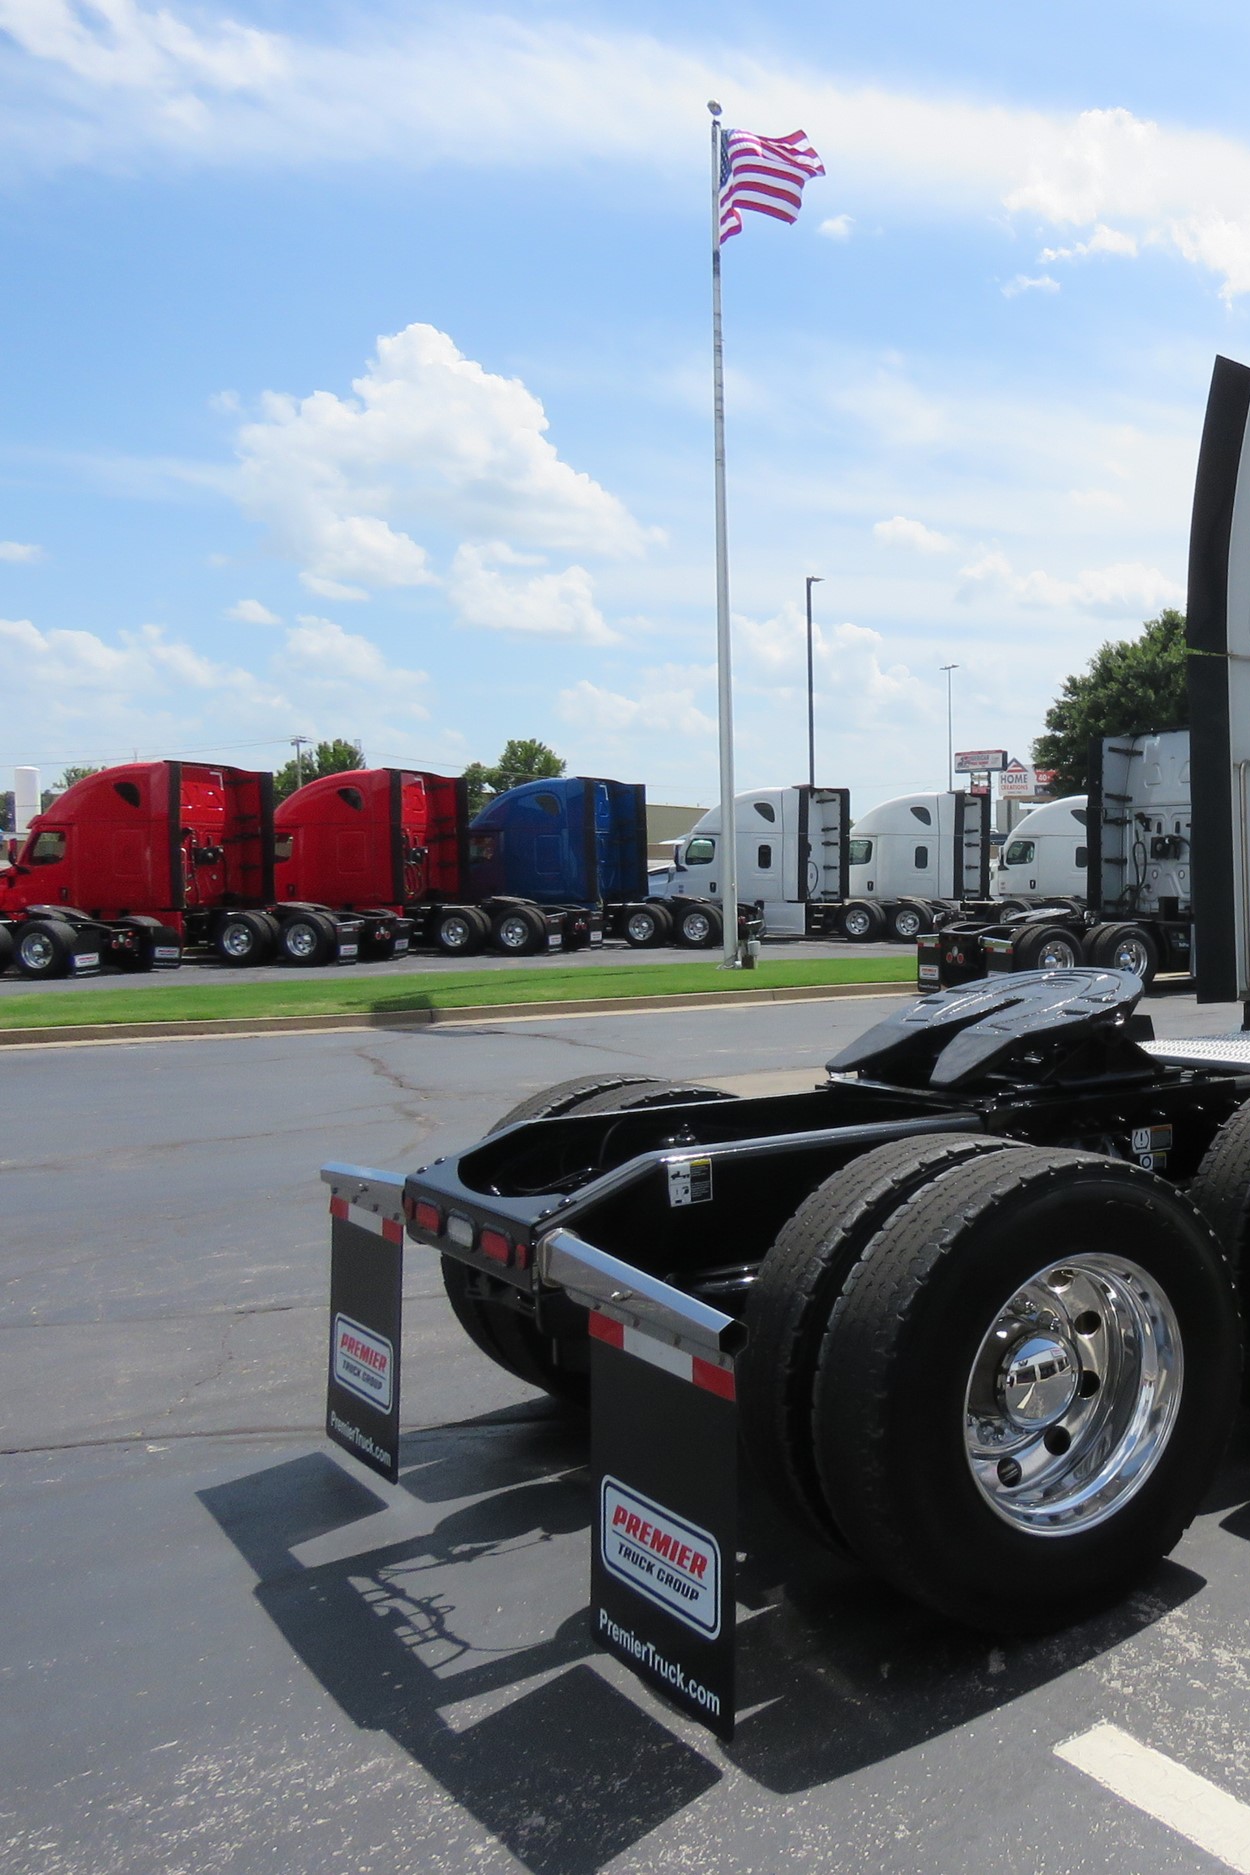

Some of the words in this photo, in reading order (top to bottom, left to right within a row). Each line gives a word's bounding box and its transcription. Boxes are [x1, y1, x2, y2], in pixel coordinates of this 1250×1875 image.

[1000, 774, 1028, 784] HOME
[340, 1333, 387, 1372] PREMIER
[342, 1360, 361, 1379] TRUCK
[362, 1372, 383, 1390] GROUP
[331, 1410, 391, 1467] PremierTruck.com
[612, 1504, 708, 1580] PREMIER
[618, 1541, 655, 1575] TRUCK
[657, 1567, 700, 1602] GROUP
[600, 1608, 720, 1716] PremierTruck.com
